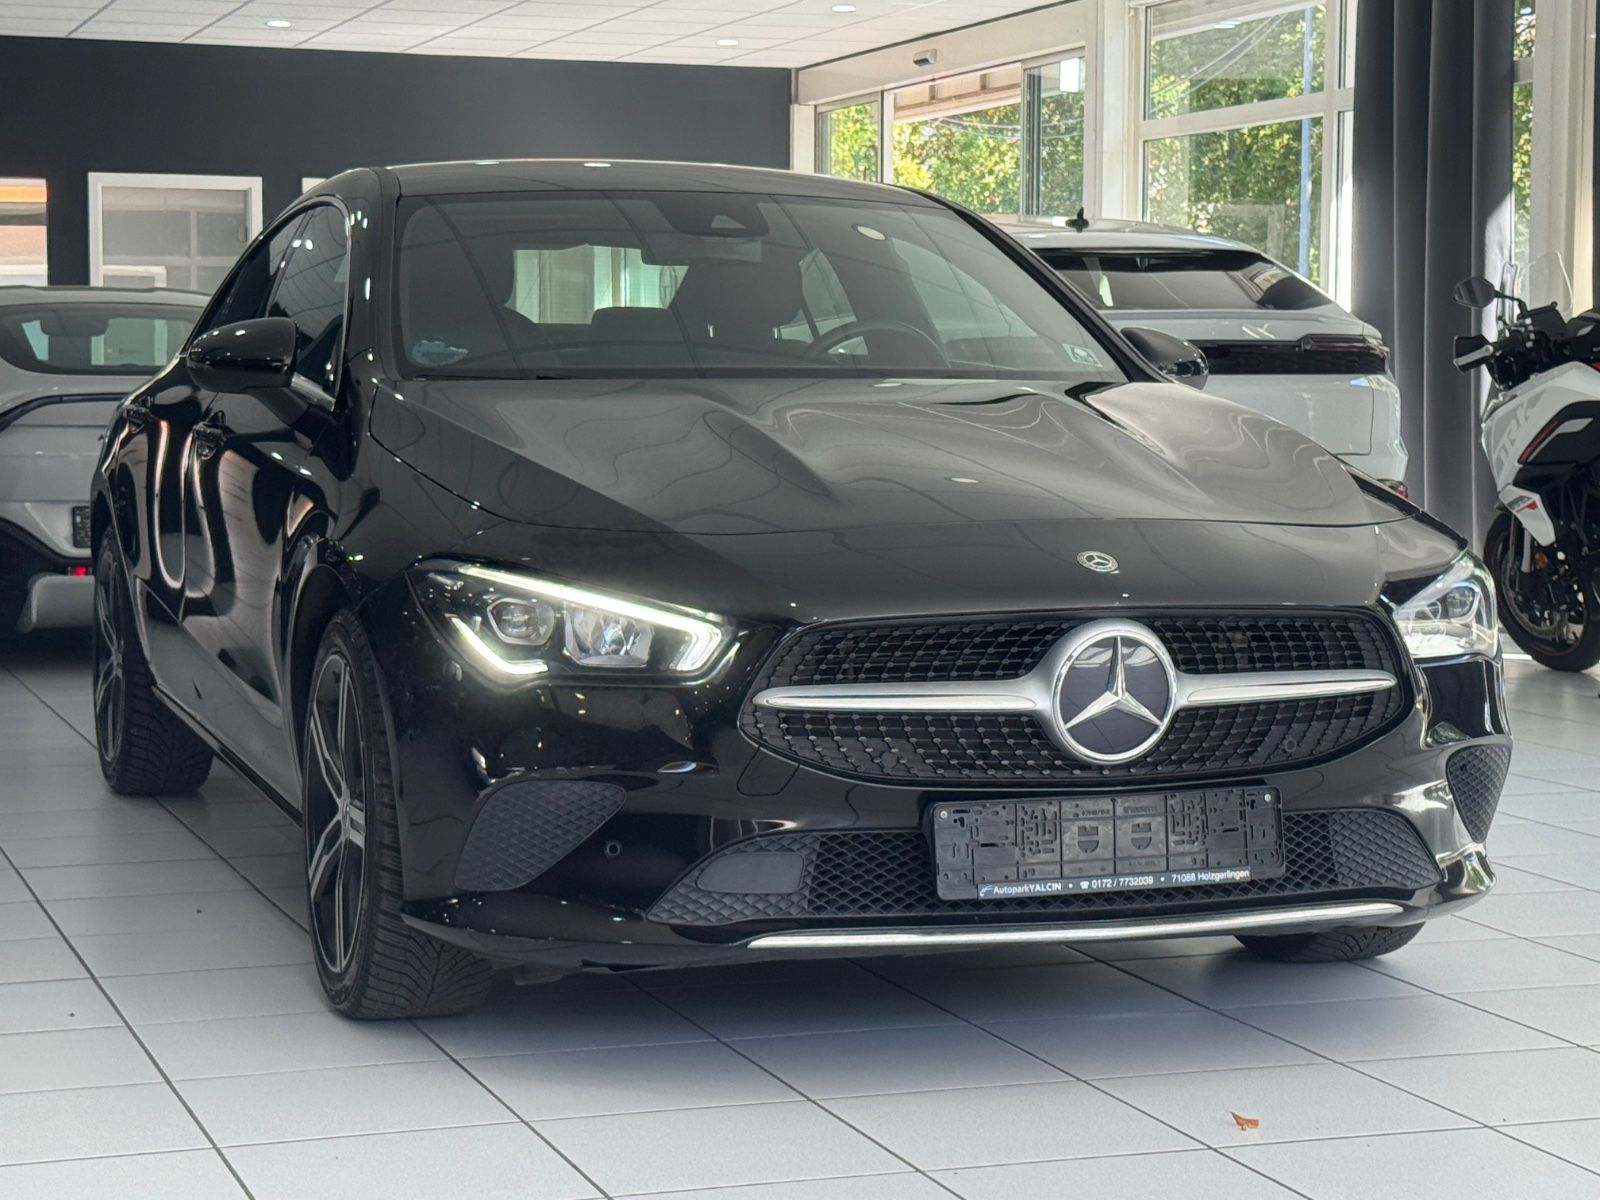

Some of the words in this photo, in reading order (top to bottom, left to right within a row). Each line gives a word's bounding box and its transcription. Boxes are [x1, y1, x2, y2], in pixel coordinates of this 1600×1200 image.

[1091, 879, 1112, 889] 0172
[1119, 876, 1154, 887] 7732039
[1198, 870, 1250, 882] Holzgerlingen
